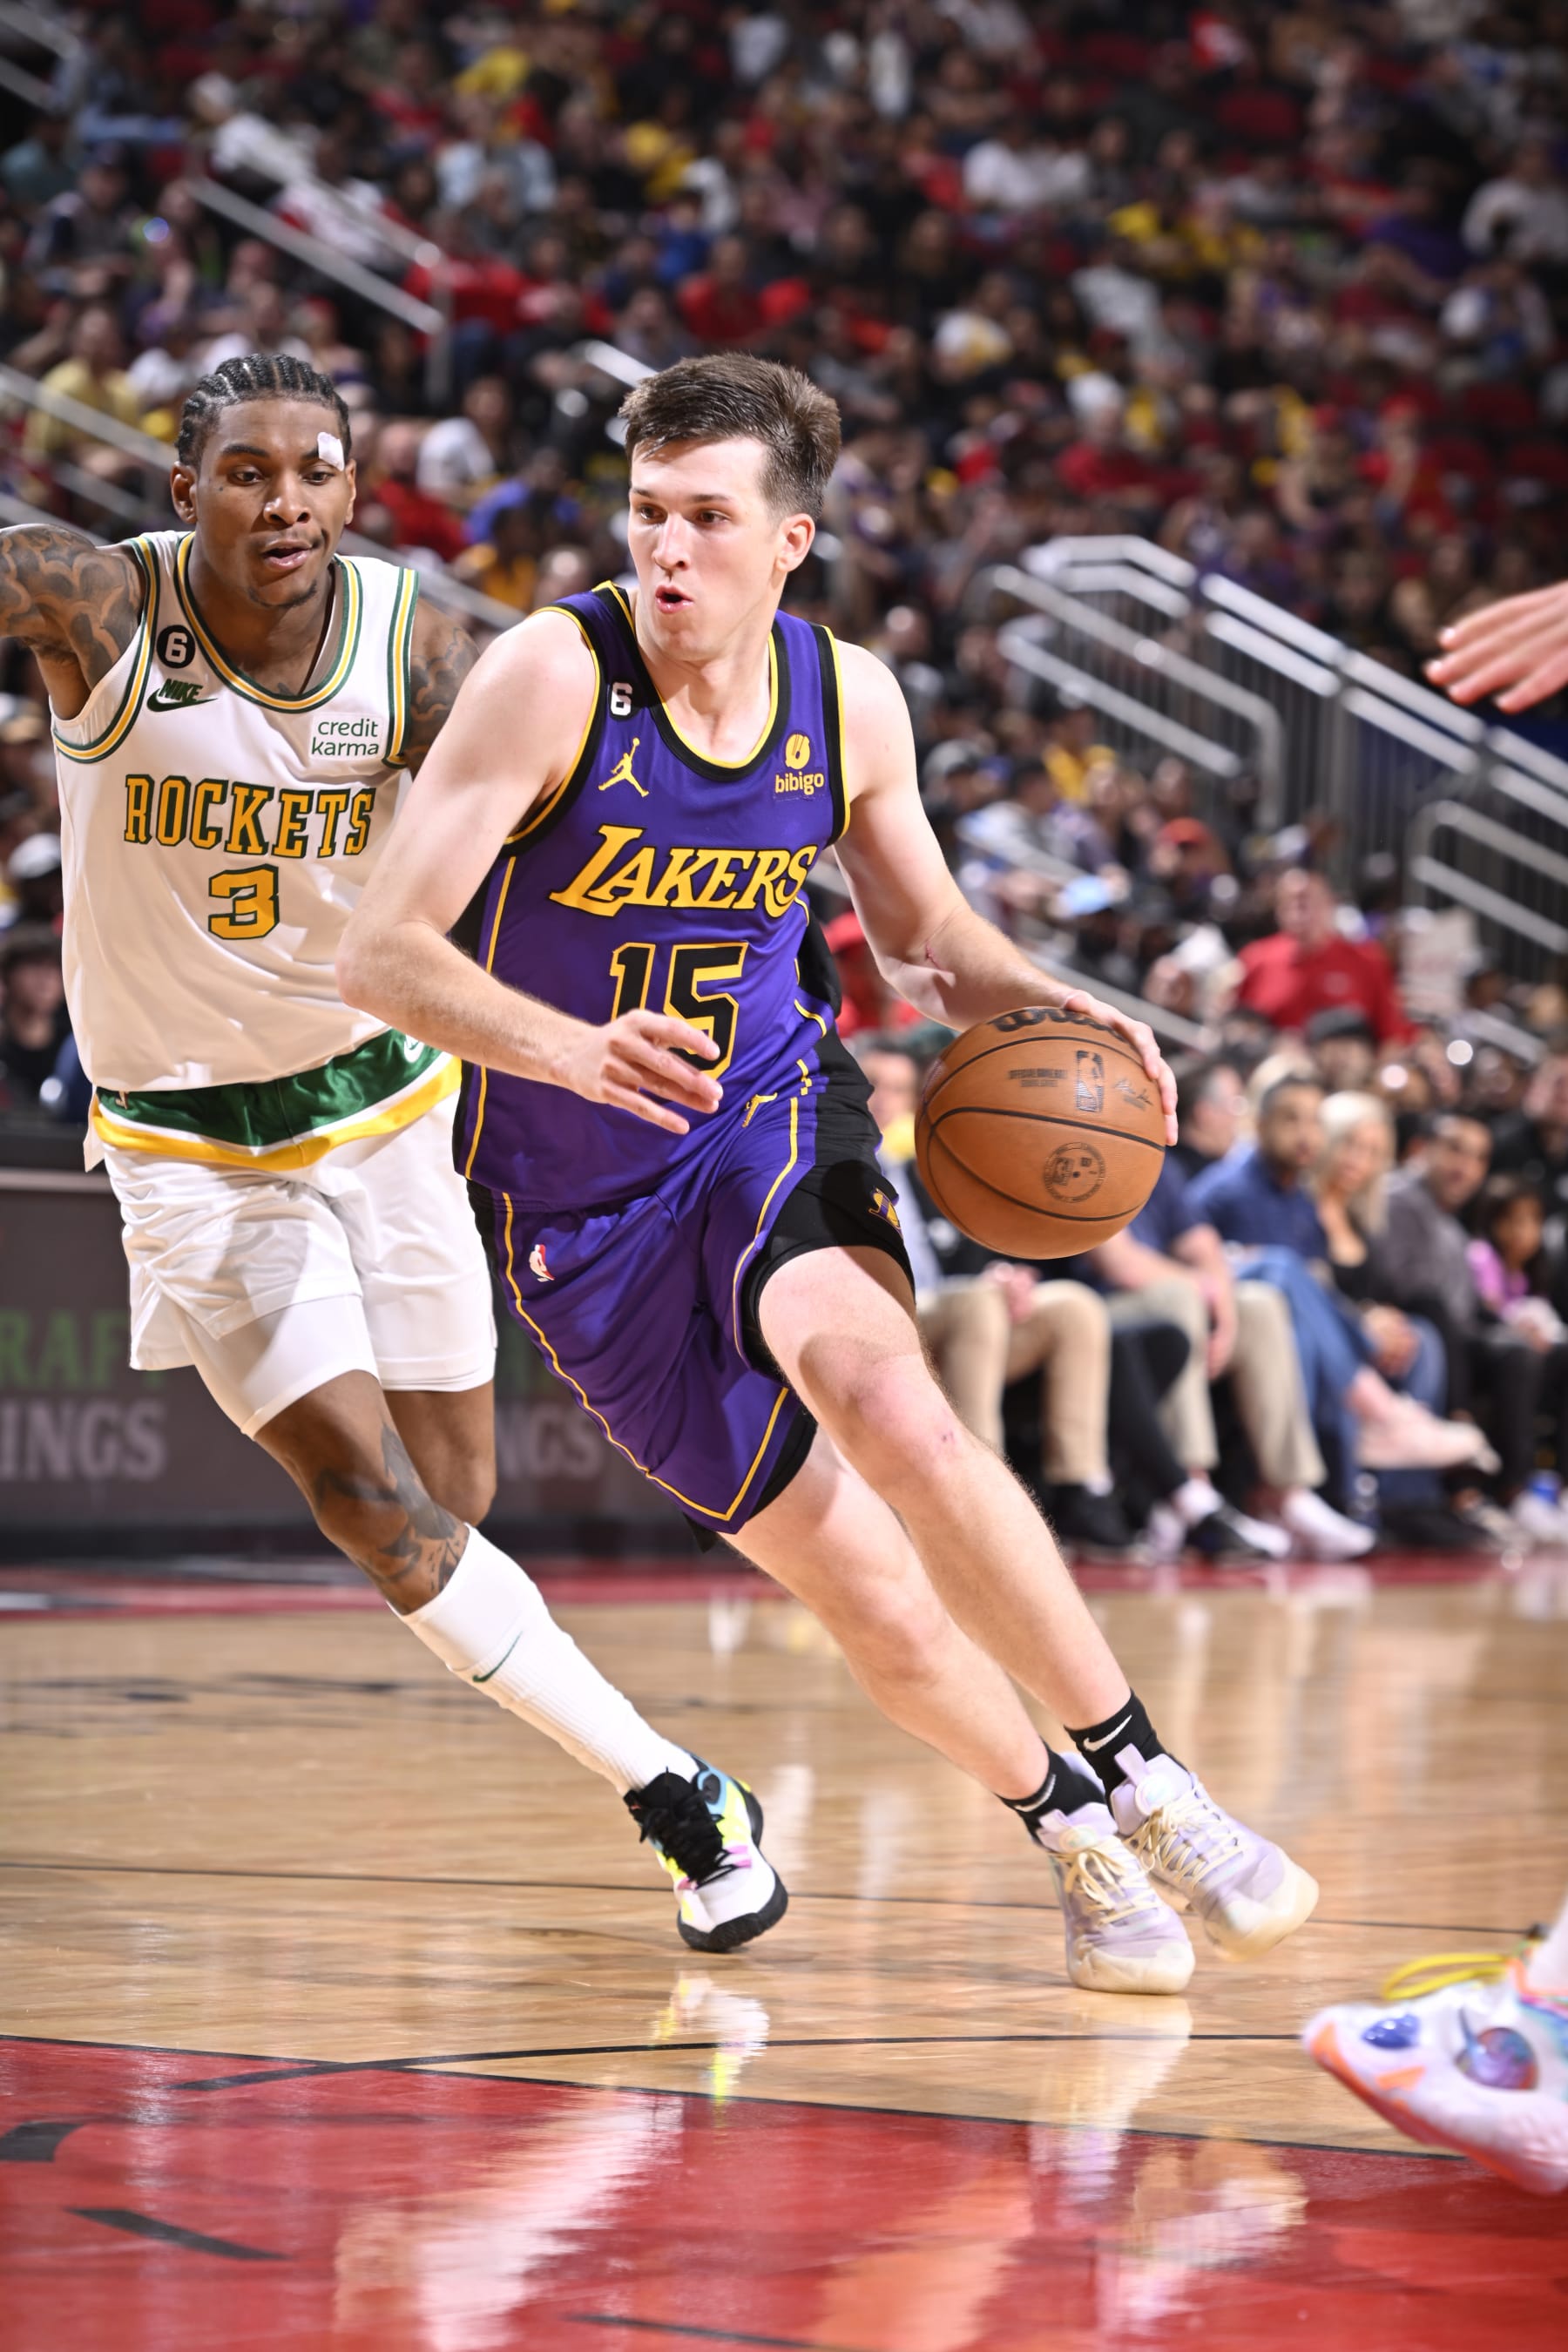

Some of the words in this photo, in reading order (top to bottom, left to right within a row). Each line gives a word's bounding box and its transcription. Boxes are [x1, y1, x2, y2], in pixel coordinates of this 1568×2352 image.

[166, 632, 188, 664] 6
[159, 679, 203, 701] NIKE
[611, 682, 632, 716] 6
[317, 719, 378, 737] credit
[311, 737, 379, 755] karma
[774, 772, 825, 796] bibigo
[124, 774, 376, 858] ROCKETS
[549, 823, 818, 918] LAKERS
[208, 863, 280, 940] 3
[610, 942, 749, 1080] 15
